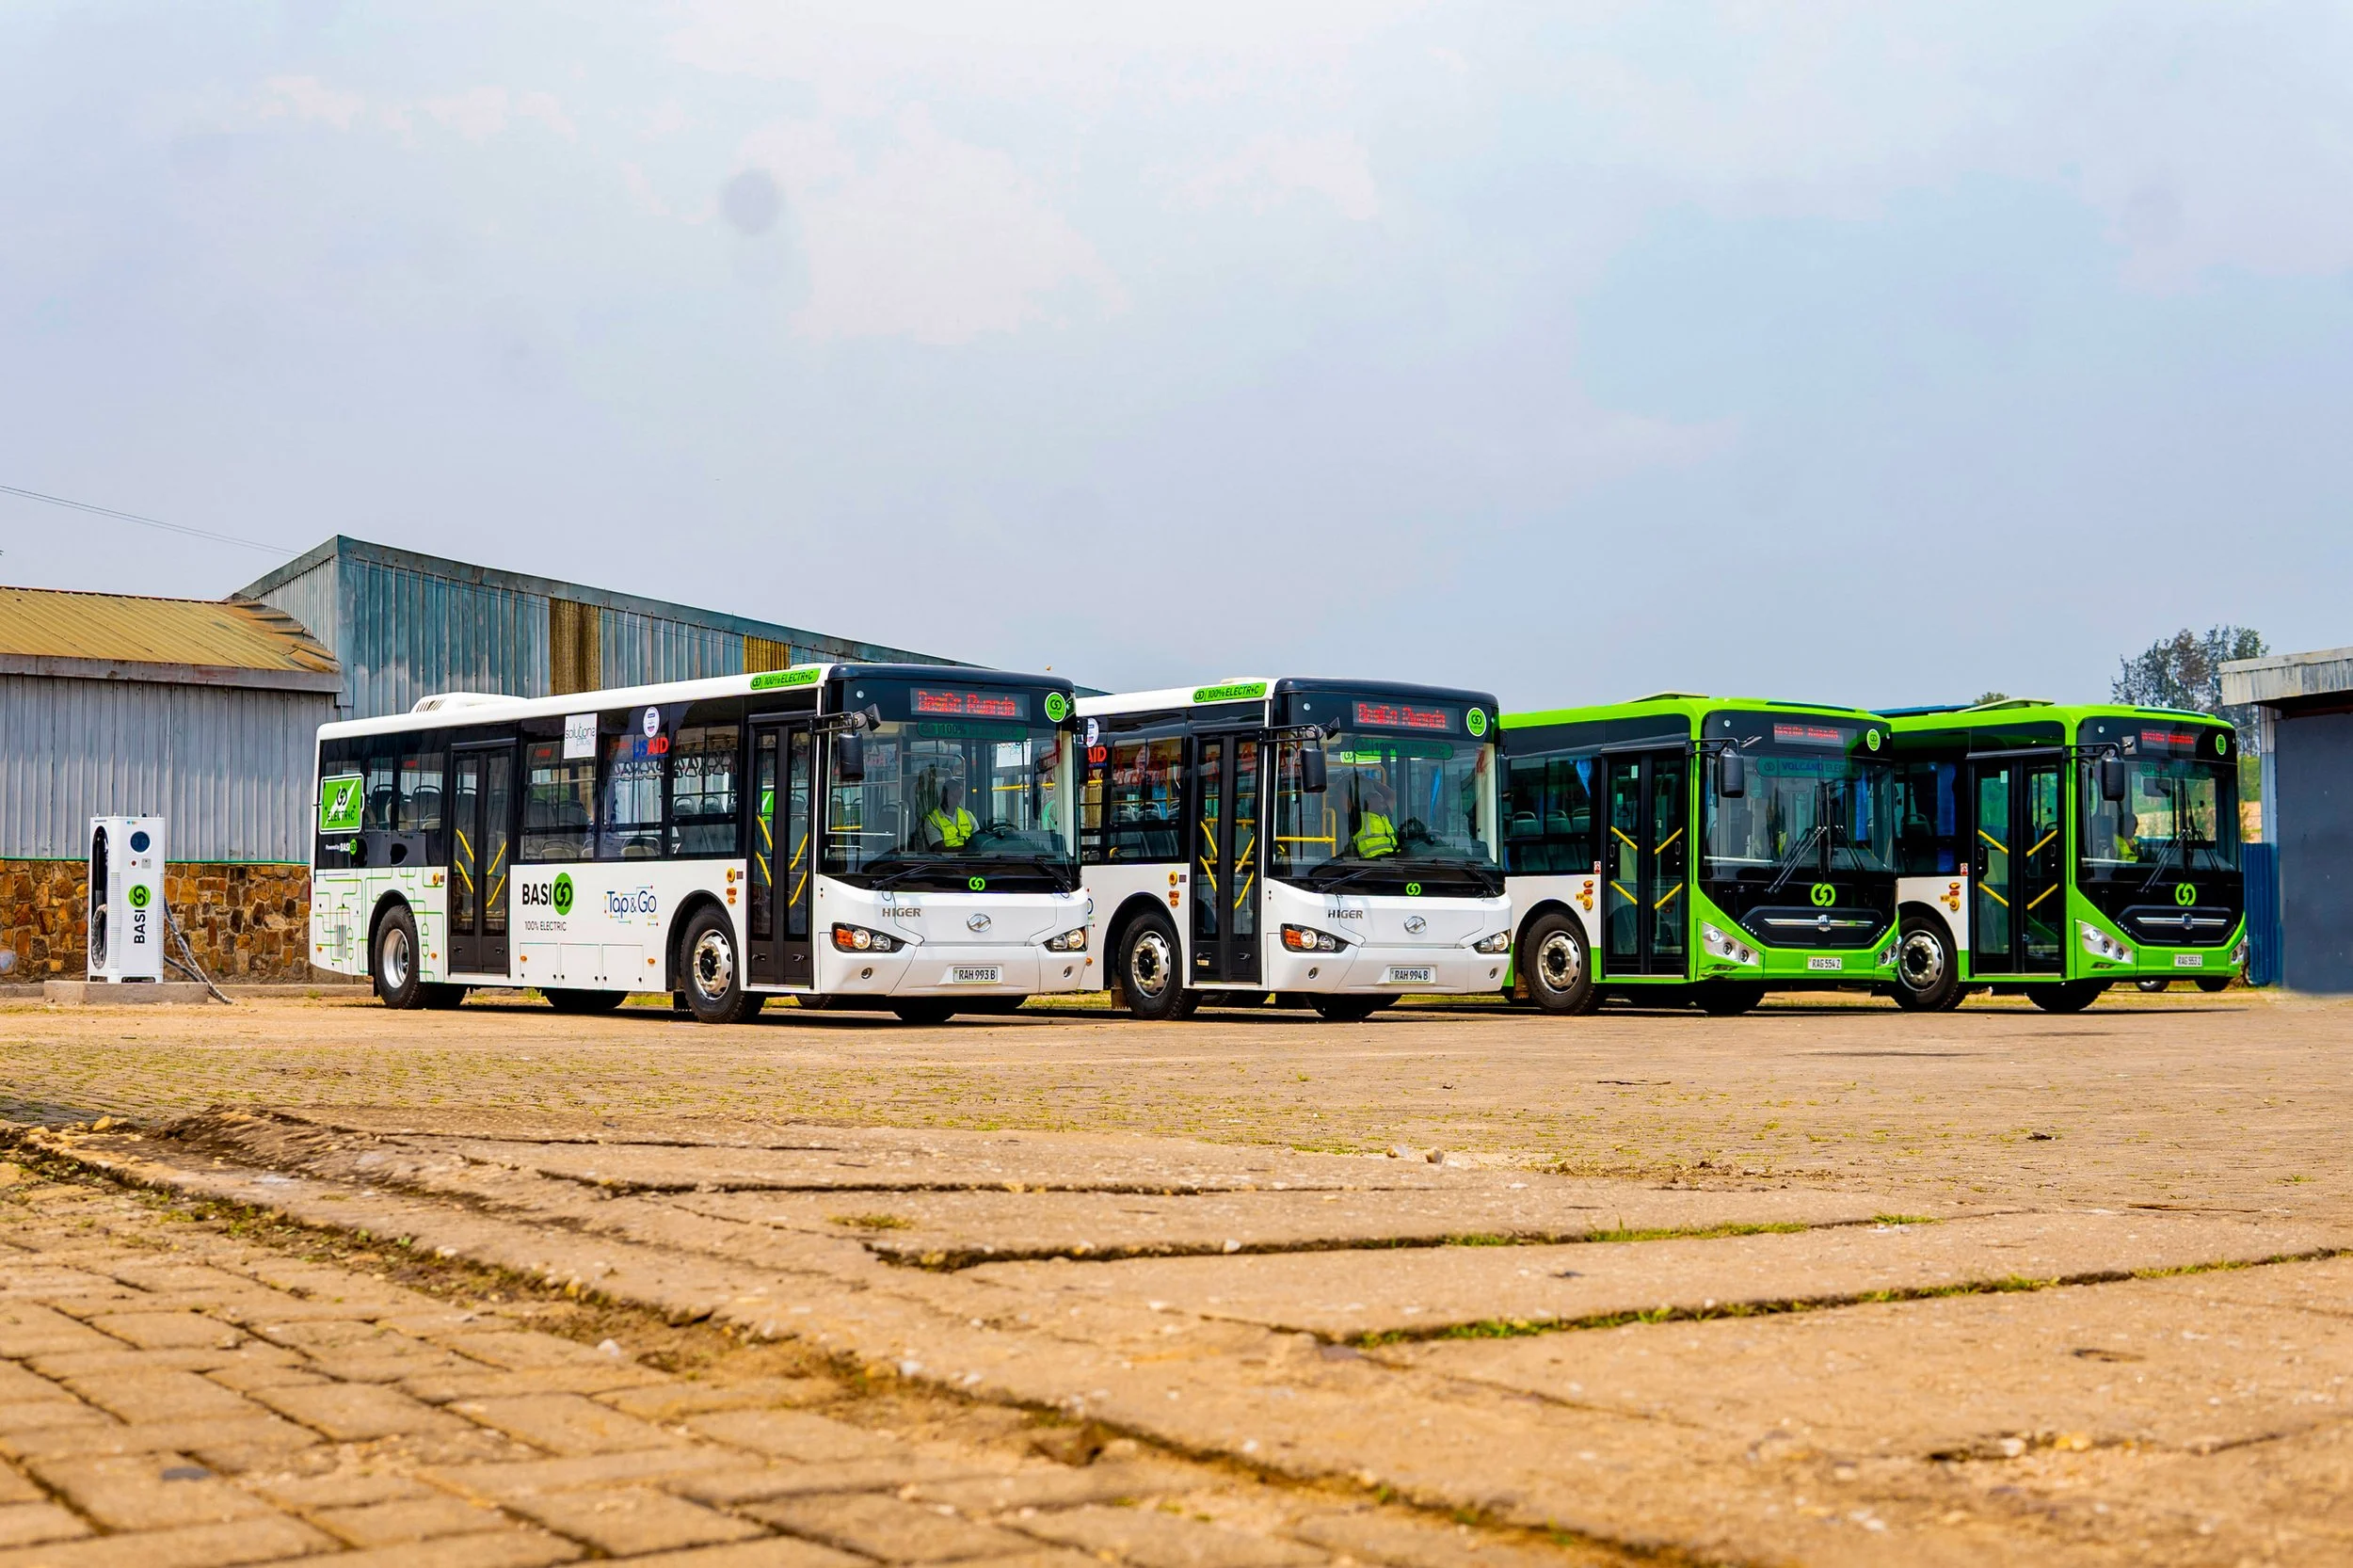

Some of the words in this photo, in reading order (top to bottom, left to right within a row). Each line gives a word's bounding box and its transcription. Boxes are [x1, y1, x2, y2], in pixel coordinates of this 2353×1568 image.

[632, 737, 669, 758] USAID
[882, 907, 921, 918] HIGER
[1327, 909, 1364, 920] HIGER
[524, 921, 539, 931] 100%
[539, 921, 567, 932] ELECTRIC
[958, 969, 973, 980] RAH
[975, 969, 989, 980] 993
[990, 969, 996, 980] B
[1394, 970, 1408, 981] RAH
[1409, 970, 1422, 981] 994
[1423, 970, 1429, 981] B
